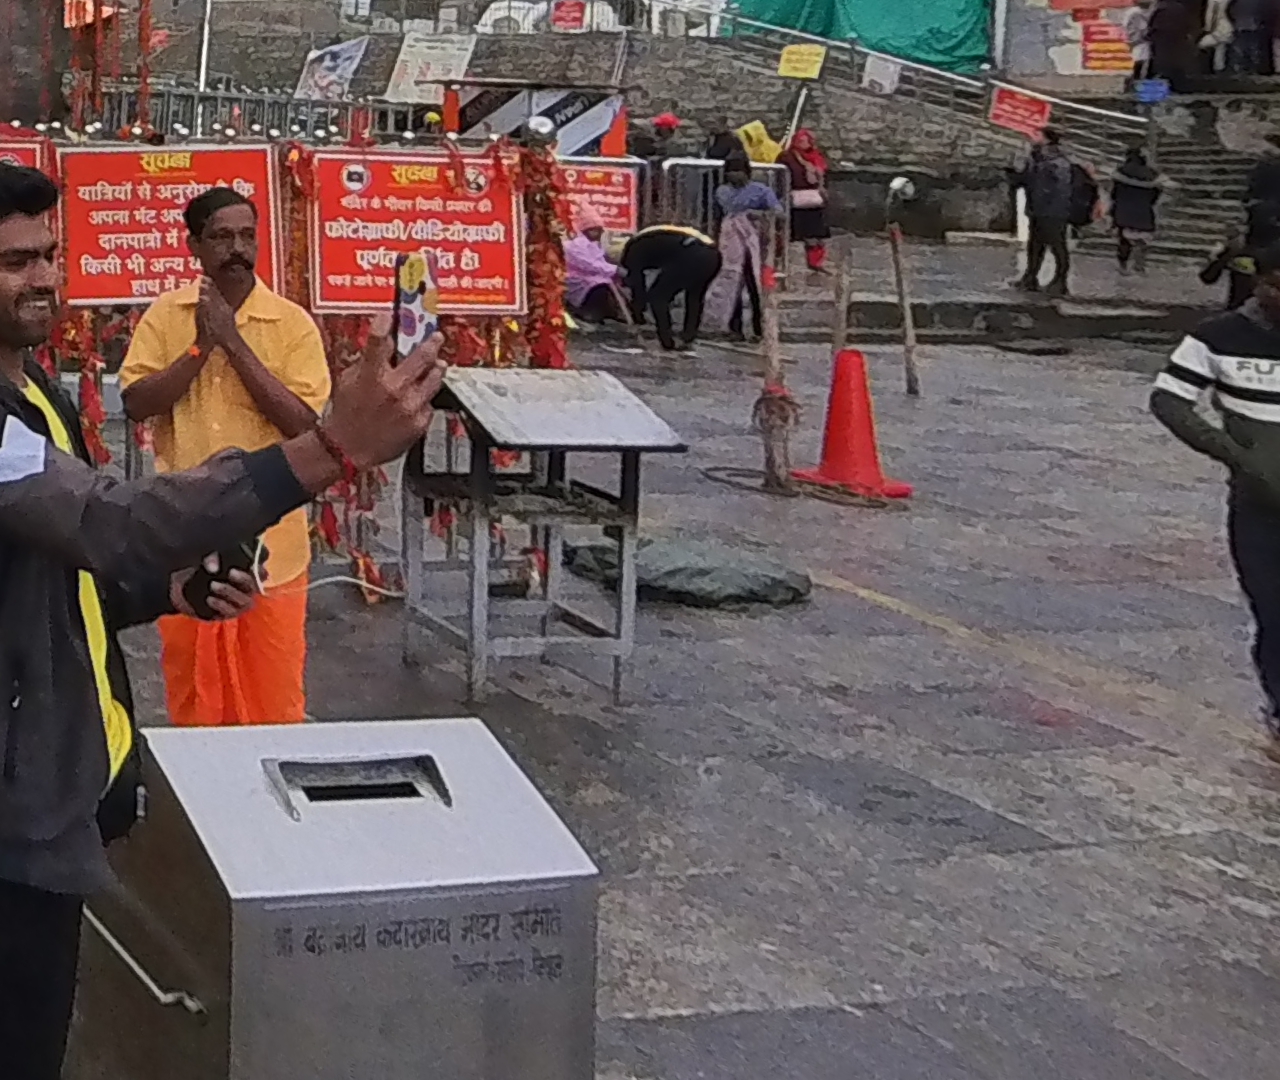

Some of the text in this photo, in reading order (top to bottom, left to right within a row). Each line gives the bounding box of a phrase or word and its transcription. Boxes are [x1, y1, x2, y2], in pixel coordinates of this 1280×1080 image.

[160, 208, 186, 225] अप
[80, 253, 122, 276] किसी
[124, 253, 146, 276] भी
[1236, 360, 1280, 376] FU
